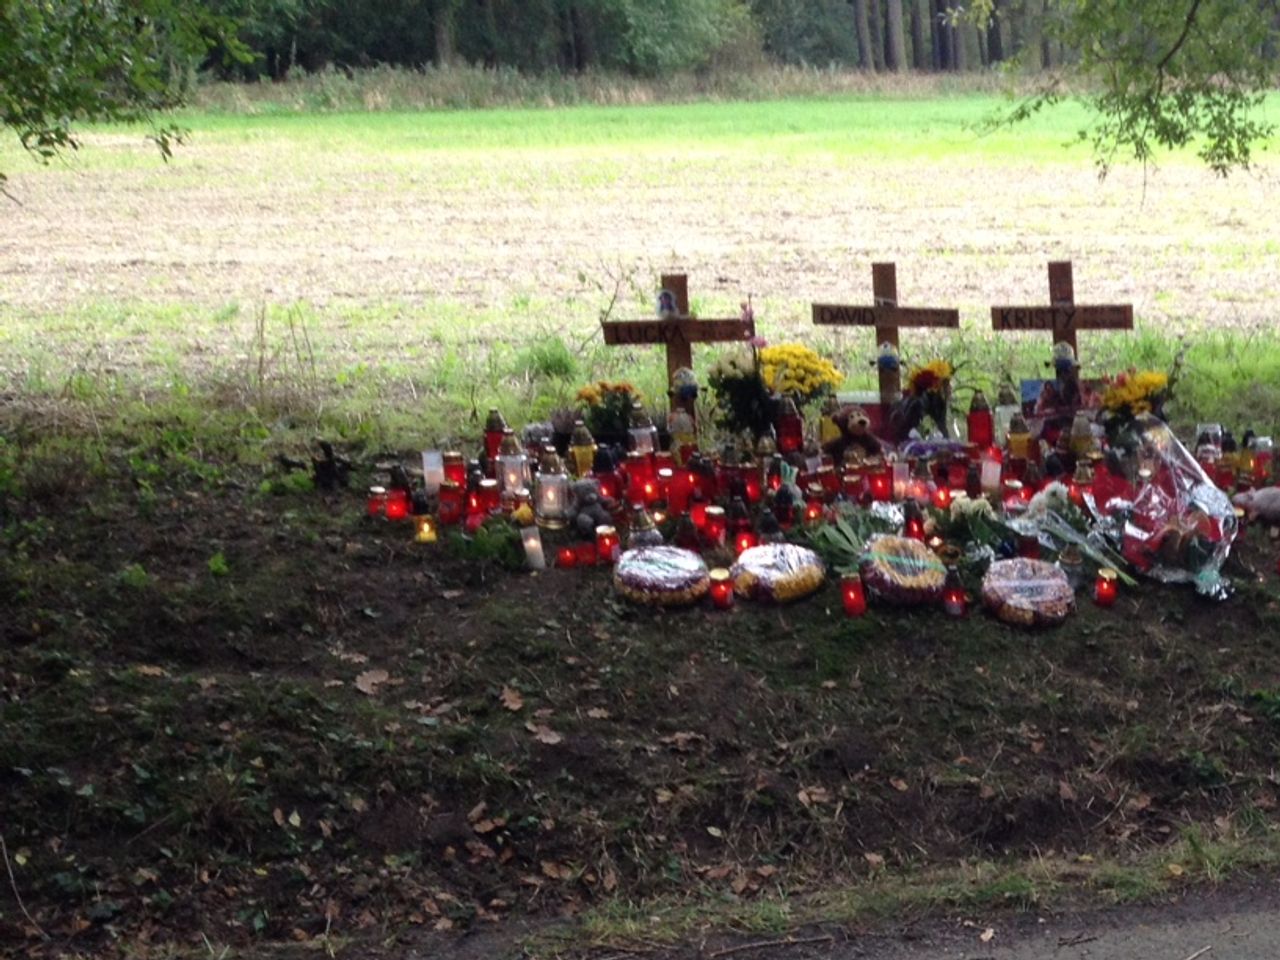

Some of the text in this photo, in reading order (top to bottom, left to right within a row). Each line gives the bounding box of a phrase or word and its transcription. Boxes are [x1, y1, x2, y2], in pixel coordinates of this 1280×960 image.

[820, 306, 876, 325] DAVID
[1000, 307, 1076, 329] KRISTY
[613, 323, 685, 344] LUCKA
